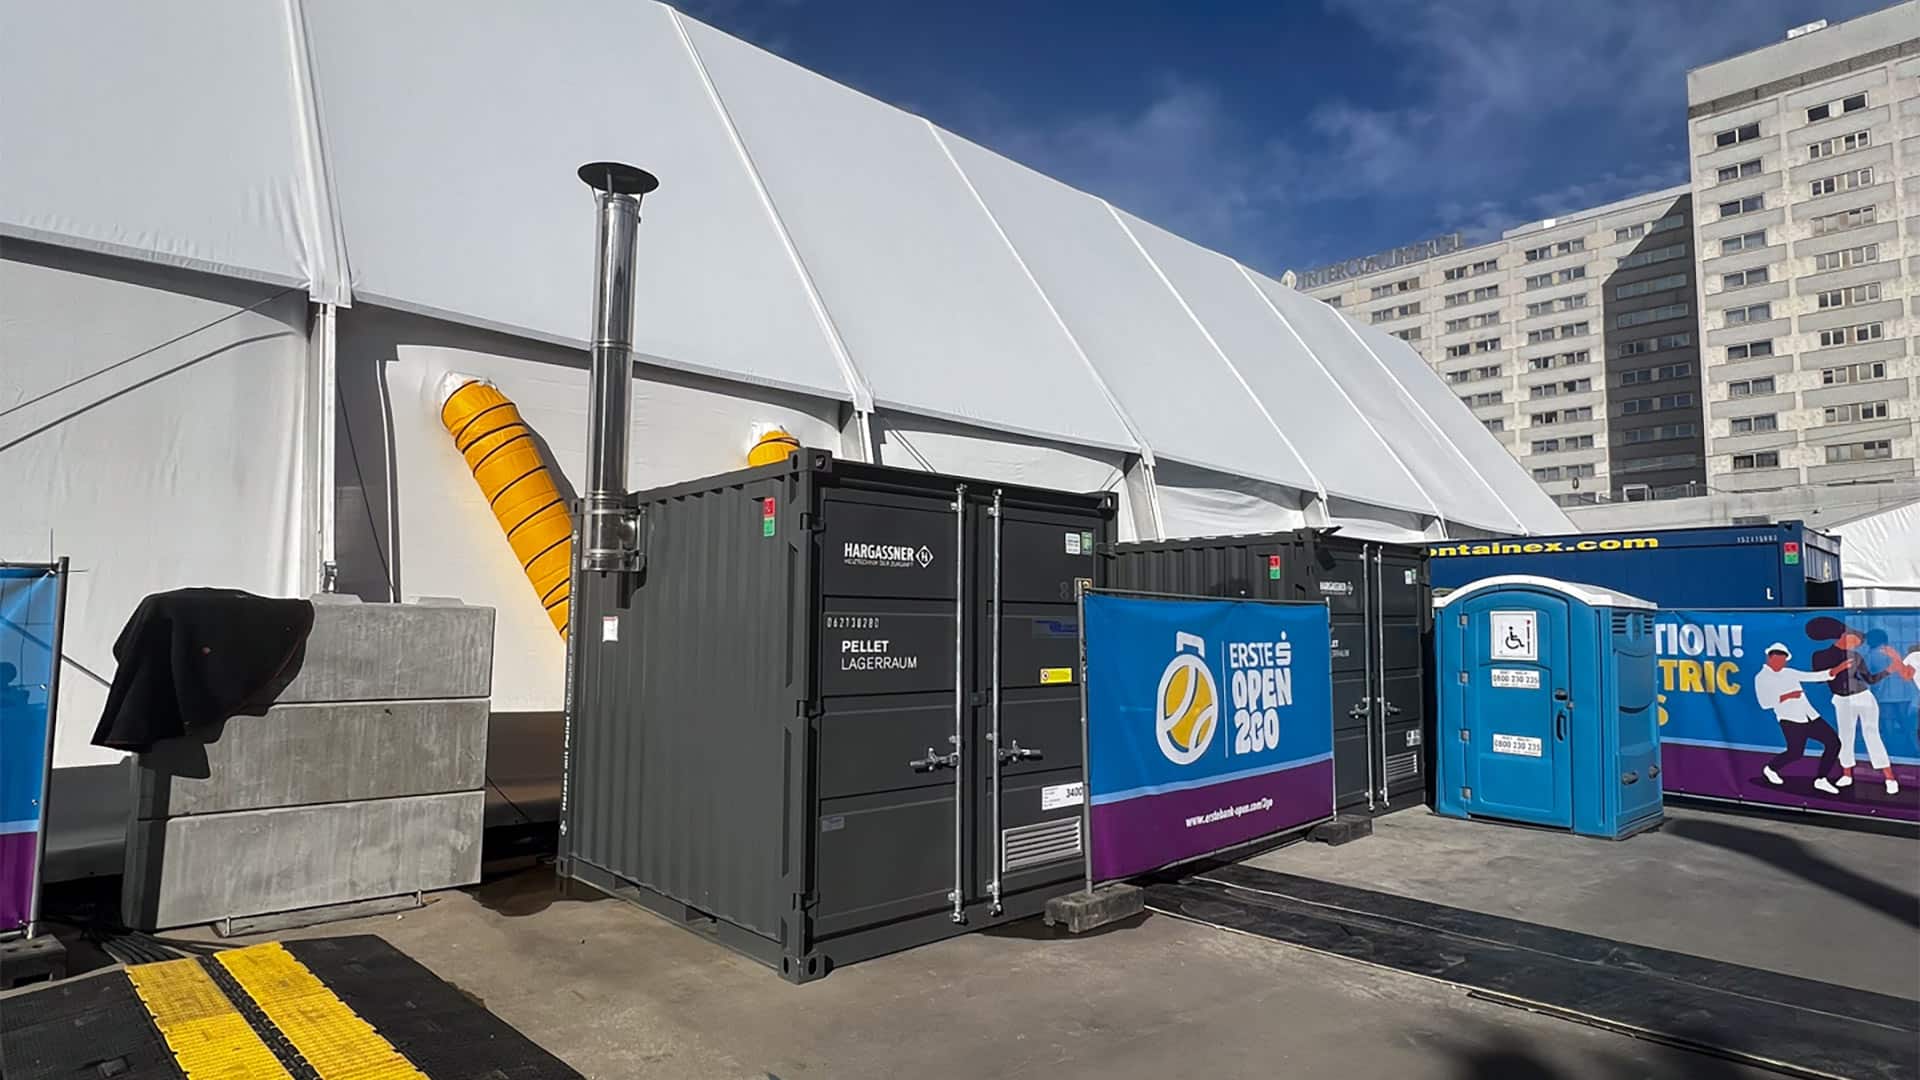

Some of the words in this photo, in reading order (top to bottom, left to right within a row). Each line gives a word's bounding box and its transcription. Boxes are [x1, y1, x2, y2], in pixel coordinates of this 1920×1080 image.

[844, 542, 914, 561] HARGASSNER
[841, 640, 889, 653] PELLET
[1229, 642, 1275, 668] ERSTE
[841, 656, 917, 671] LAGERRAUM
[1232, 667, 1292, 713] OPEN
[1234, 708, 1280, 754] 2GO
